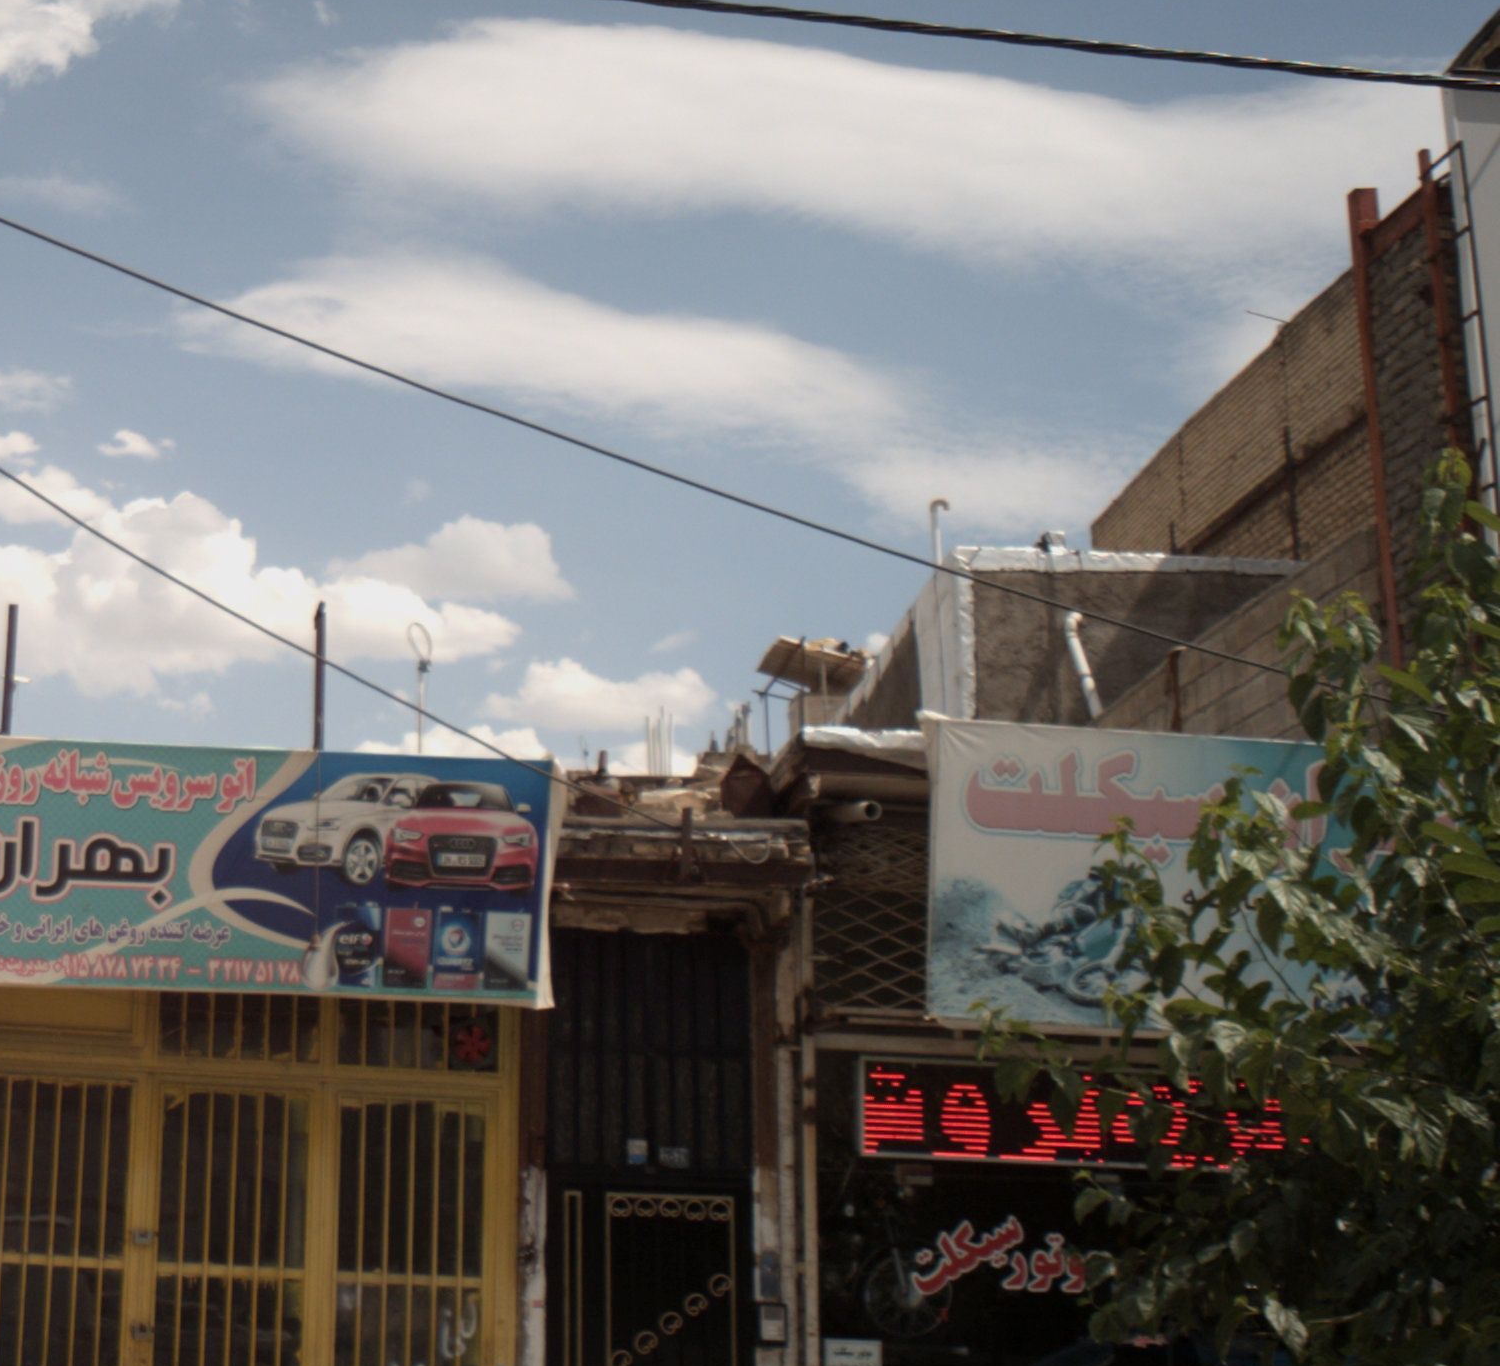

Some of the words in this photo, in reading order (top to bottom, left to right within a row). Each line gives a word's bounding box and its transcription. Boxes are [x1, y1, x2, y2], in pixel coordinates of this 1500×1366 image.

[43, 750, 112, 806] شبانه
[12, 922, 23, 943] و
[25, 914, 73, 943] ایرانی
[73, 917, 104, 943] های
[107, 918, 146, 947] روغن
[150, 920, 190, 942] کننده
[192, 921, 231, 948] عرضه
[911, 1215, 1024, 1295] سیکلت
[1002, 1233, 1087, 1293] وتور
